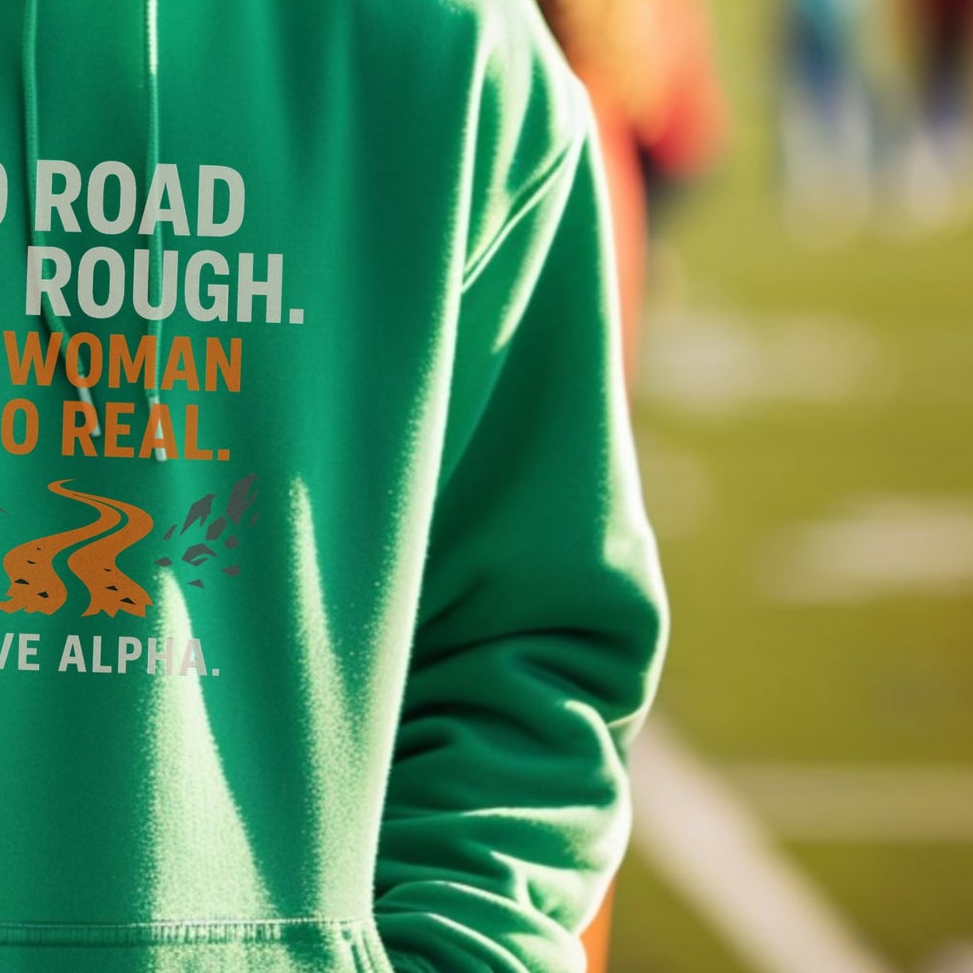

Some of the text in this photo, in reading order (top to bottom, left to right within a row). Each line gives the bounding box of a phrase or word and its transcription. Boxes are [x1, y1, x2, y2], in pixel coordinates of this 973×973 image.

[34, 159, 245, 237] ROAD
[26, 245, 304, 324] ROUGH.
[3, 330, 242, 392] WOMAN
[61, 400, 230, 461] REAL.
[58, 635, 220, 676] ALPHA.
